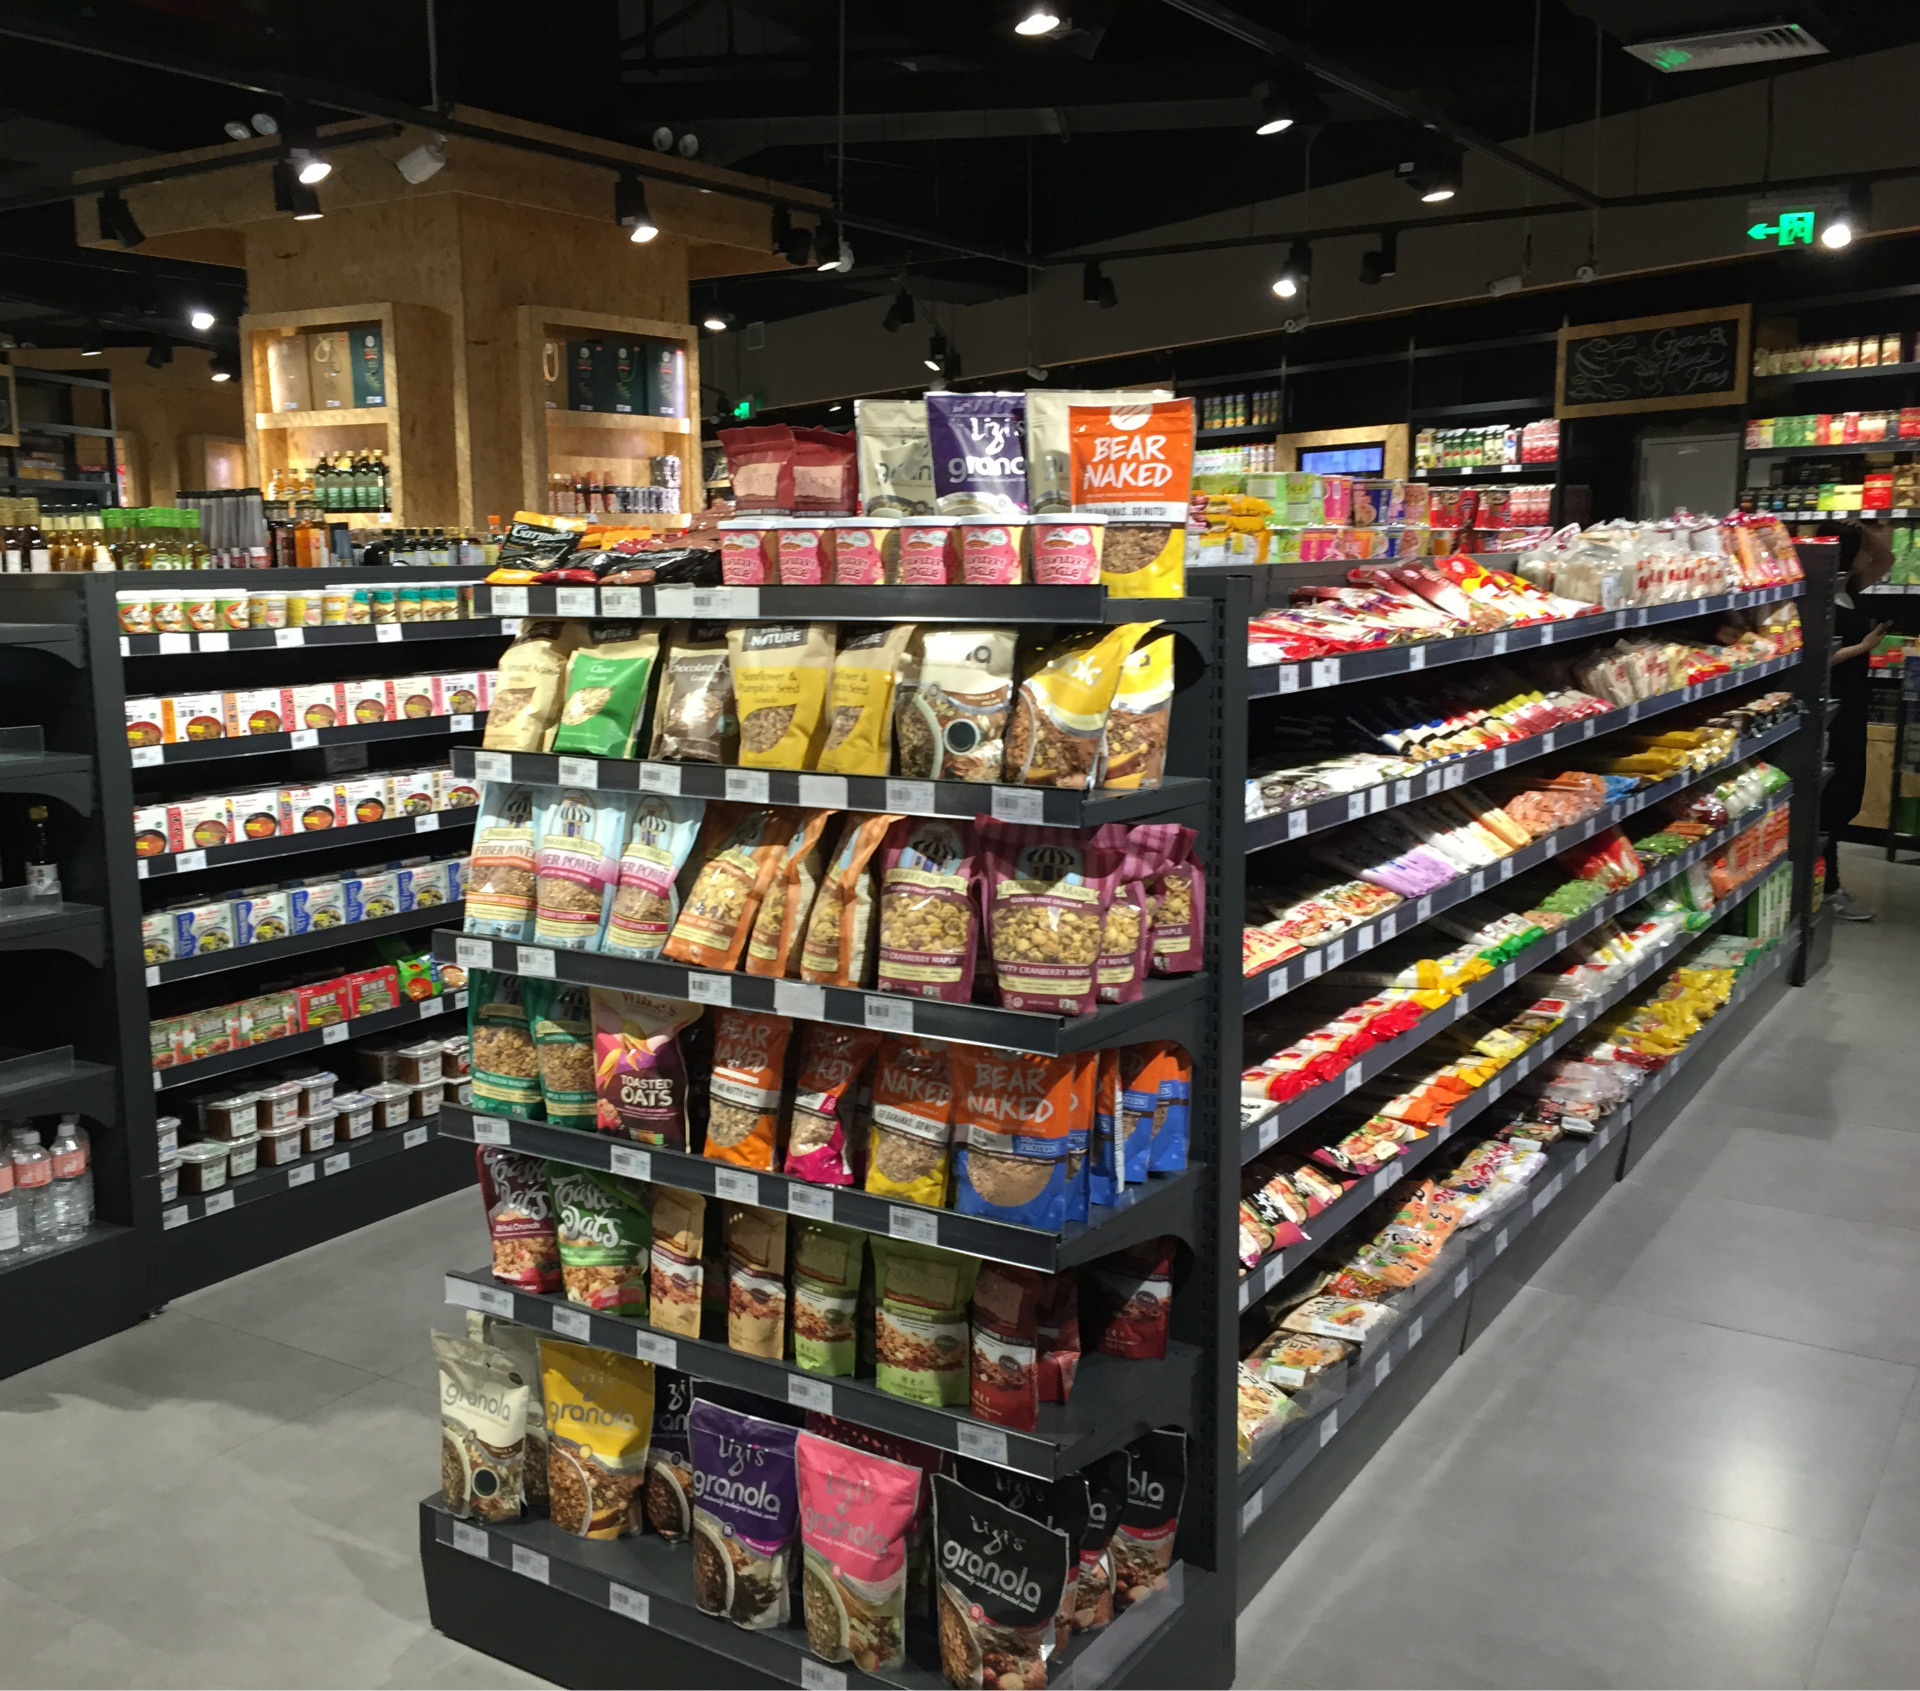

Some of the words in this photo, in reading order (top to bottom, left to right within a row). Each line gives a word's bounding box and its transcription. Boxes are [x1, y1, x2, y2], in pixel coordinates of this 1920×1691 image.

[1091, 435, 1167, 462] BEAR
[1083, 462, 1173, 490] NAKED
[889, 952, 929, 963] CRANBERRY
[931, 955, 957, 964] MAPLE
[1019, 966, 1066, 977] CRANBERRY
[620, 1075, 673, 1089] TOASTED
[974, 1063, 1047, 1095] BEAR
[620, 1086, 673, 1107] OATS
[967, 1090, 1054, 1123] NAKED
[557, 1205, 622, 1248] Oats
[444, 1382, 511, 1422] granola
[550, 1400, 635, 1431] granola
[693, 1470, 781, 1513] granola
[803, 1507, 889, 1554] granola
[943, 1540, 1042, 1606] granola
